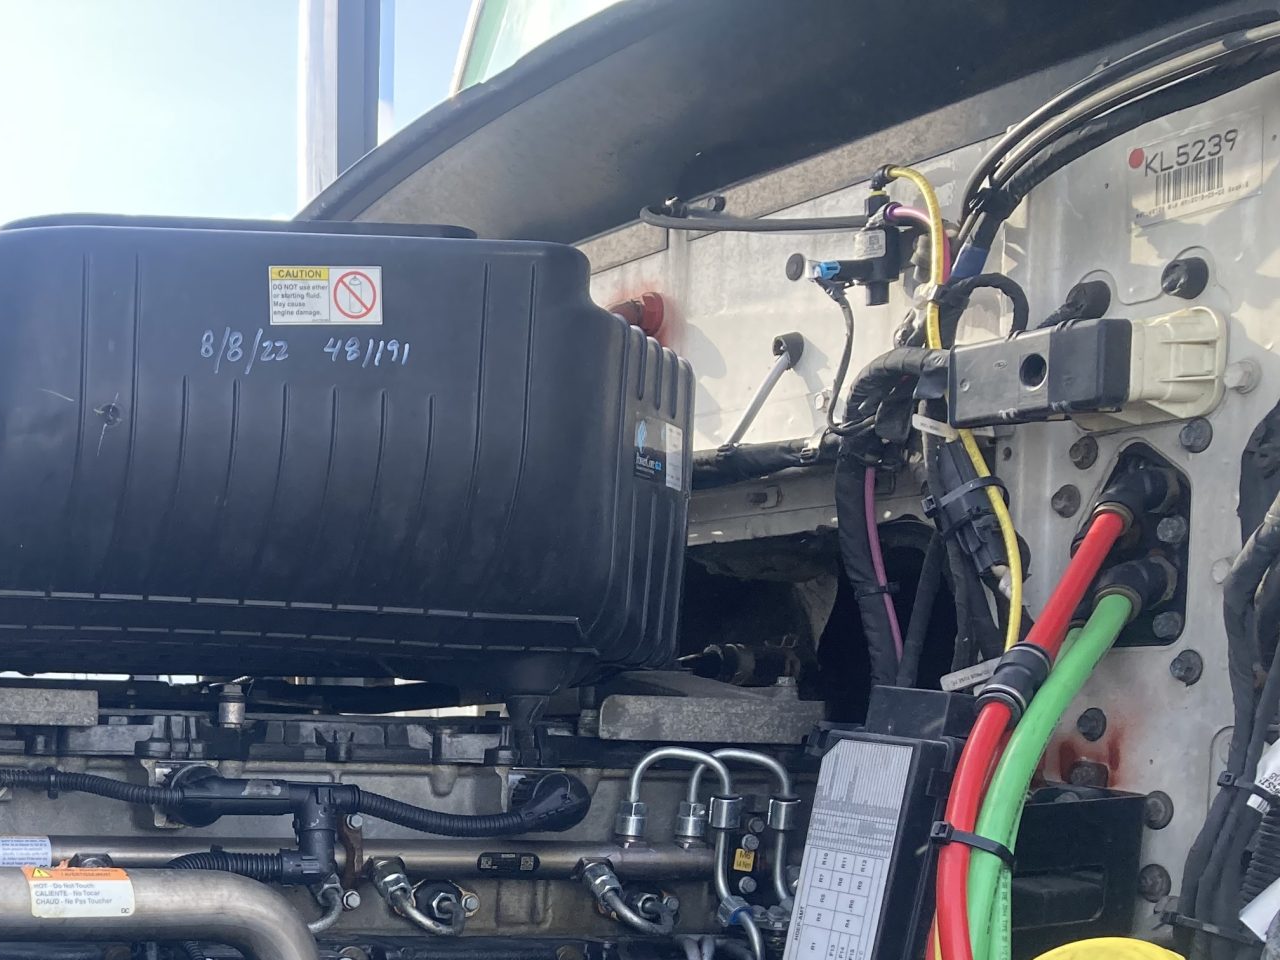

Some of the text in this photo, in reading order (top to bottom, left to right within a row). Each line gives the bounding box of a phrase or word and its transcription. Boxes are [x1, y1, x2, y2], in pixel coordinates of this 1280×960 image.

[1144, 128, 1239, 177] KL5239
[278, 269, 322, 279] CAUTION
[281, 292, 305, 300] starting
[273, 309, 294, 317] engine
[200, 327, 289, 375] 8/8/22
[840, 857, 848, 869] R11
[818, 874, 825, 883] R7
[845, 919, 851, 928] R4
[810, 942, 816, 951] R1
